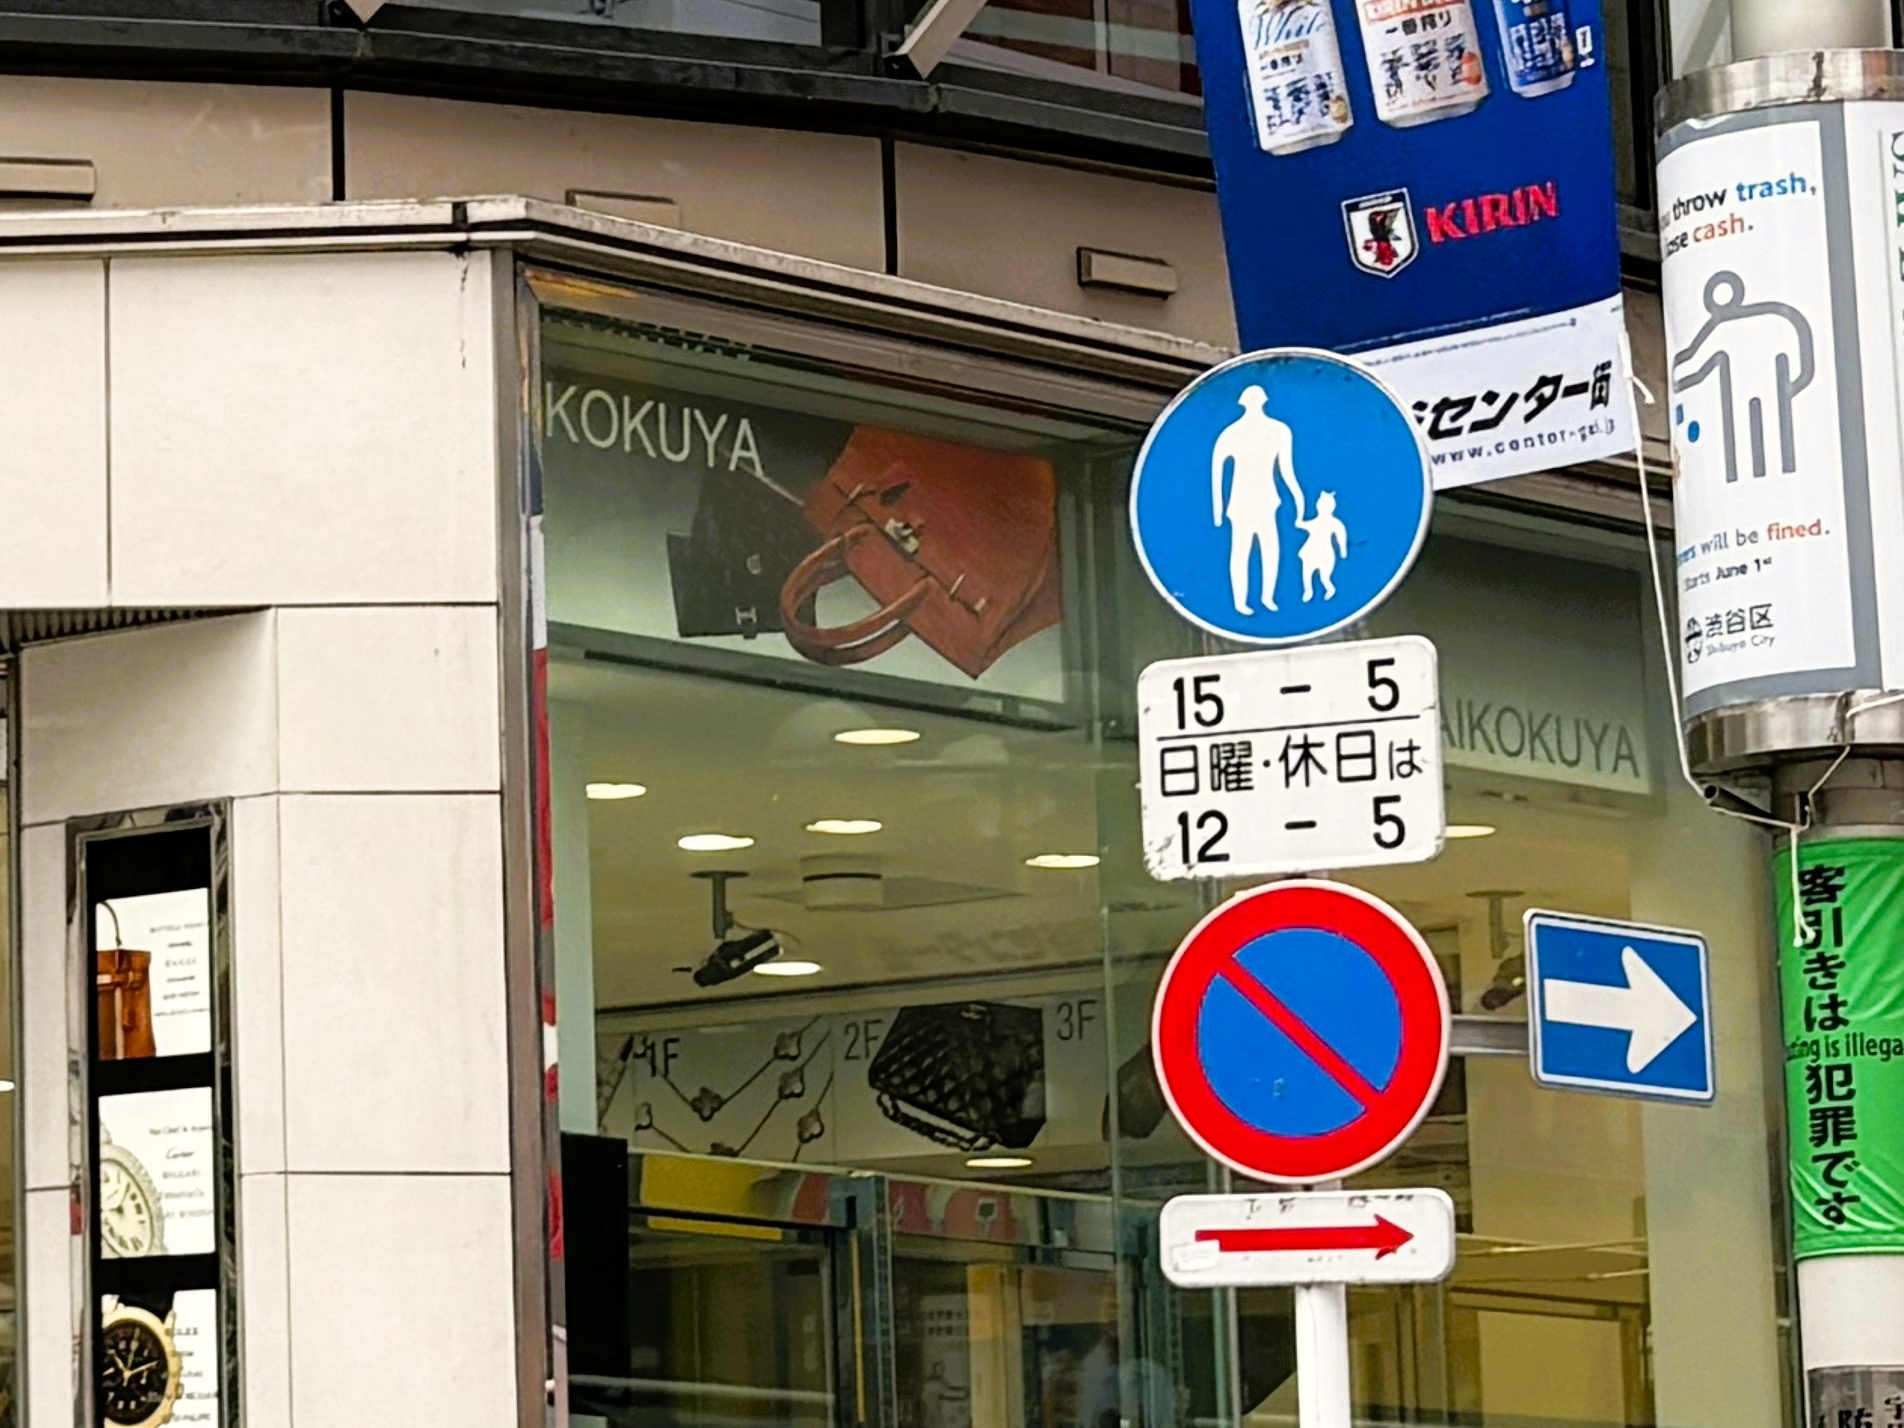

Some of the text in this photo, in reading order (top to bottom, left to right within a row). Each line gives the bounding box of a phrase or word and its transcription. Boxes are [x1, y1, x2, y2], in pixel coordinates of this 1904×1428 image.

[1735, 173, 1818, 202] trash,
[1424, 180, 1560, 245] KIRIN
[1692, 213, 1755, 245] cash.
[1413, 359, 1612, 441] センター街
[1735, 528, 1760, 548] be
[1766, 517, 1831, 542] fined.
[1704, 602, 1774, 639] 渋谷区
[1172, 673, 1225, 729] 15
[1366, 657, 1401, 713] 5
[1159, 729, 1425, 798] 日曜・休日は
[1177, 809, 1231, 864] 12
[1372, 795, 1407, 850] 5
[844, 1019, 883, 1061] 2F
[1056, 1000, 1099, 1042] 3F
[1799, 863, 1862, 1231] 客引きは犯罪です
[1824, 1034, 1841, 1058] is
